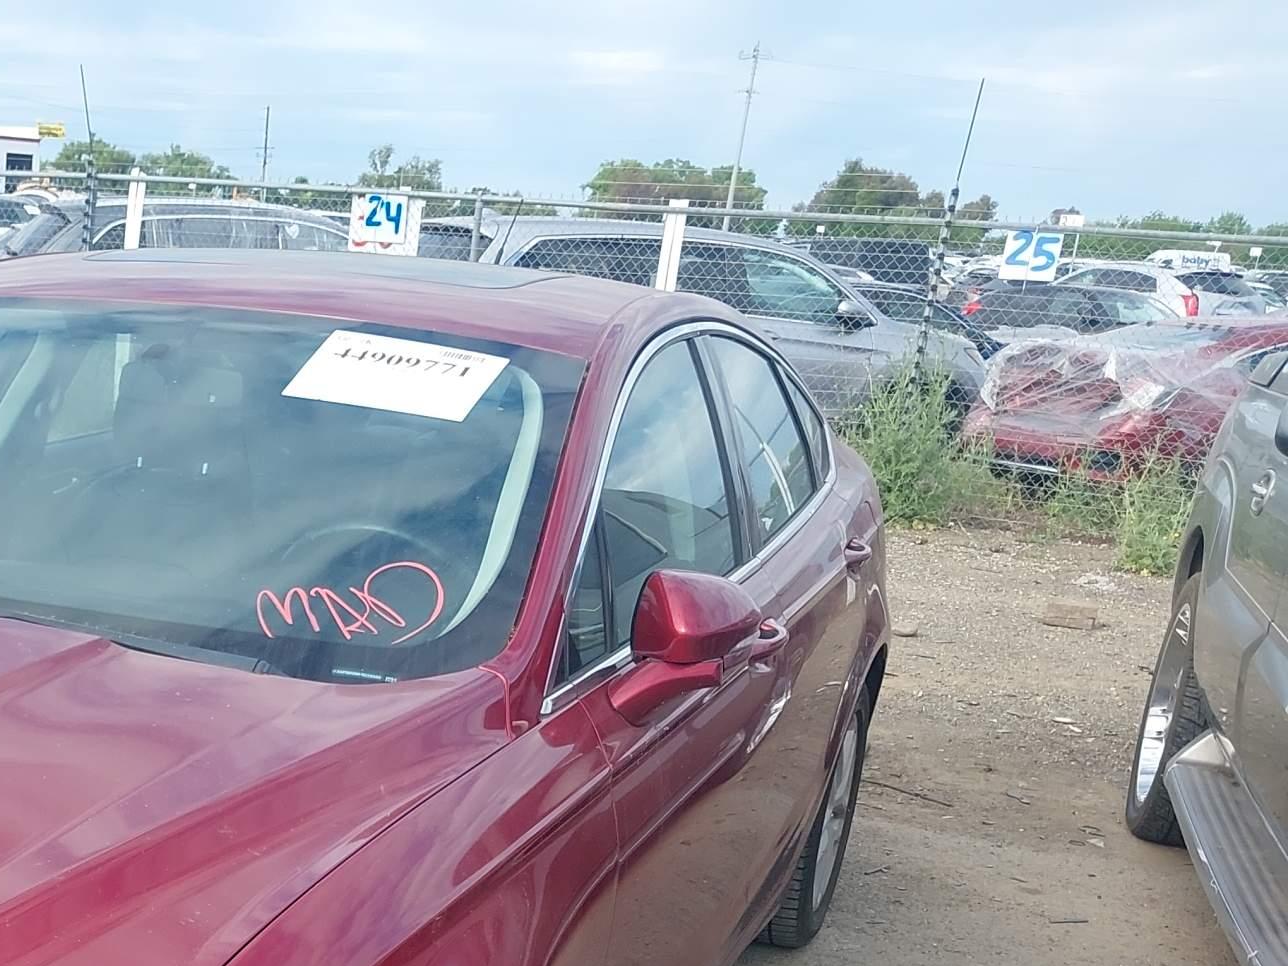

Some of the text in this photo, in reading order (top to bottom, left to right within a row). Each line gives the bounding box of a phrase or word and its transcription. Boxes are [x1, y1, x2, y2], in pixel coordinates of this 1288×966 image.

[365, 195, 403, 235] 24
[1005, 229, 1061, 272] 25
[333, 346, 472, 378] 44909771
